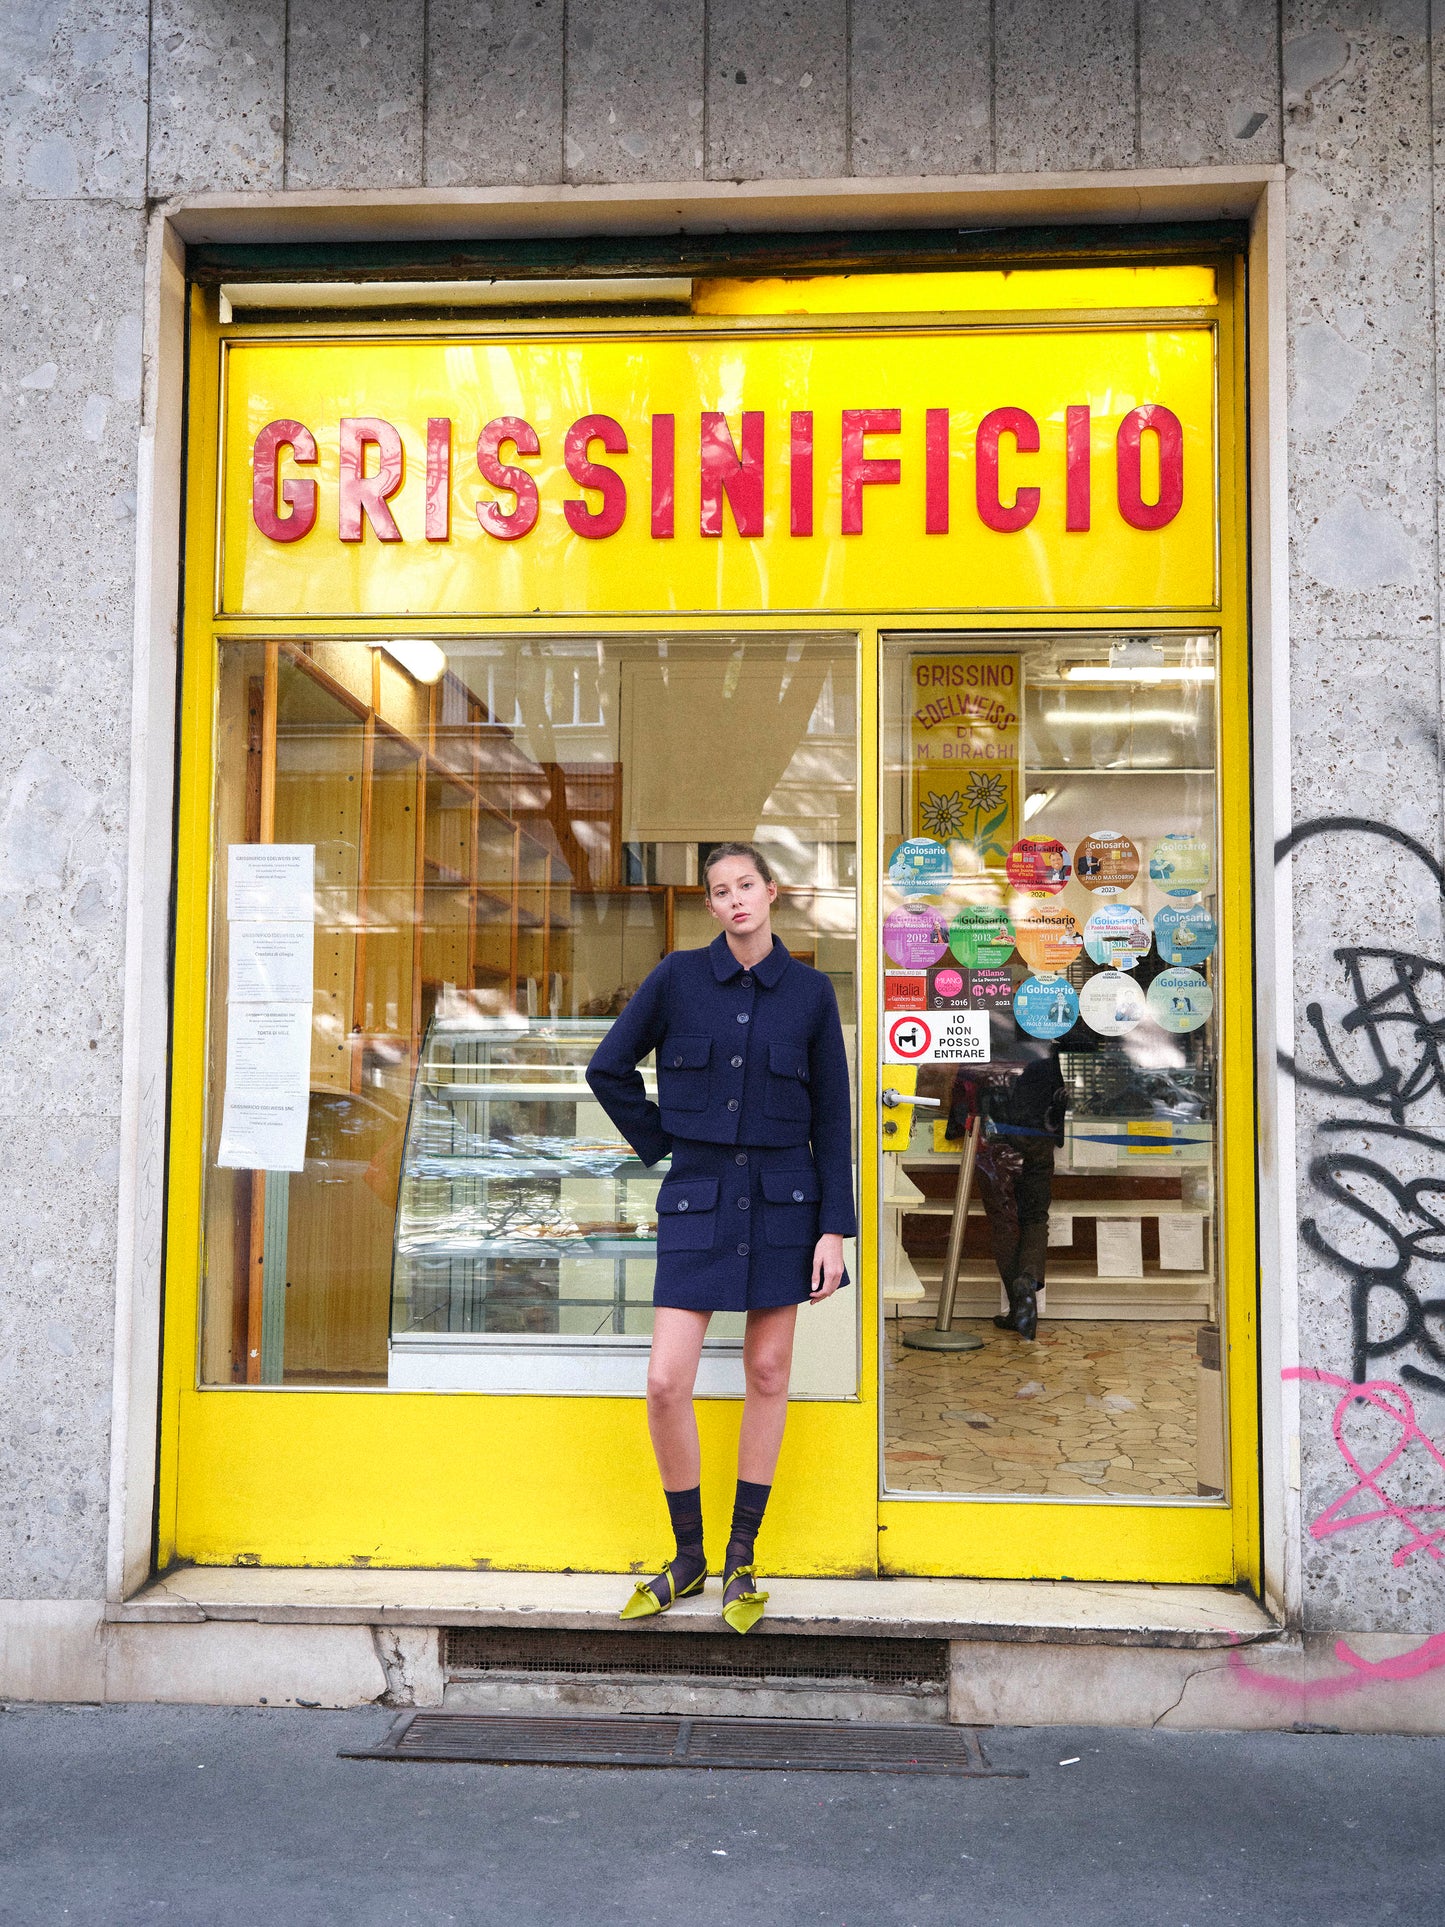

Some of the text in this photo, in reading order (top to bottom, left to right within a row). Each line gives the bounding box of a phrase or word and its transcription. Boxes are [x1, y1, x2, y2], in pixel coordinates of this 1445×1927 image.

[252, 404, 1184, 544] GRISSINIFICIO
[916, 664, 1015, 688] GRISSINO
[914, 693, 1017, 732] EDELWEISS
[956, 726, 974, 739] DI
[917, 743, 1015, 760] M. BIRAGHI
[1030, 891, 1046, 899] 2024
[1101, 886, 1116, 894] 2023
[906, 933, 929, 943] 2012
[972, 933, 992, 942] 2013
[936, 977, 962, 985] MILANO
[952, 1014, 966, 1024] IO
[946, 1026, 972, 1036] NON
[939, 1037, 980, 1047] POSSO
[934, 1049, 985, 1059] ENTRARE
